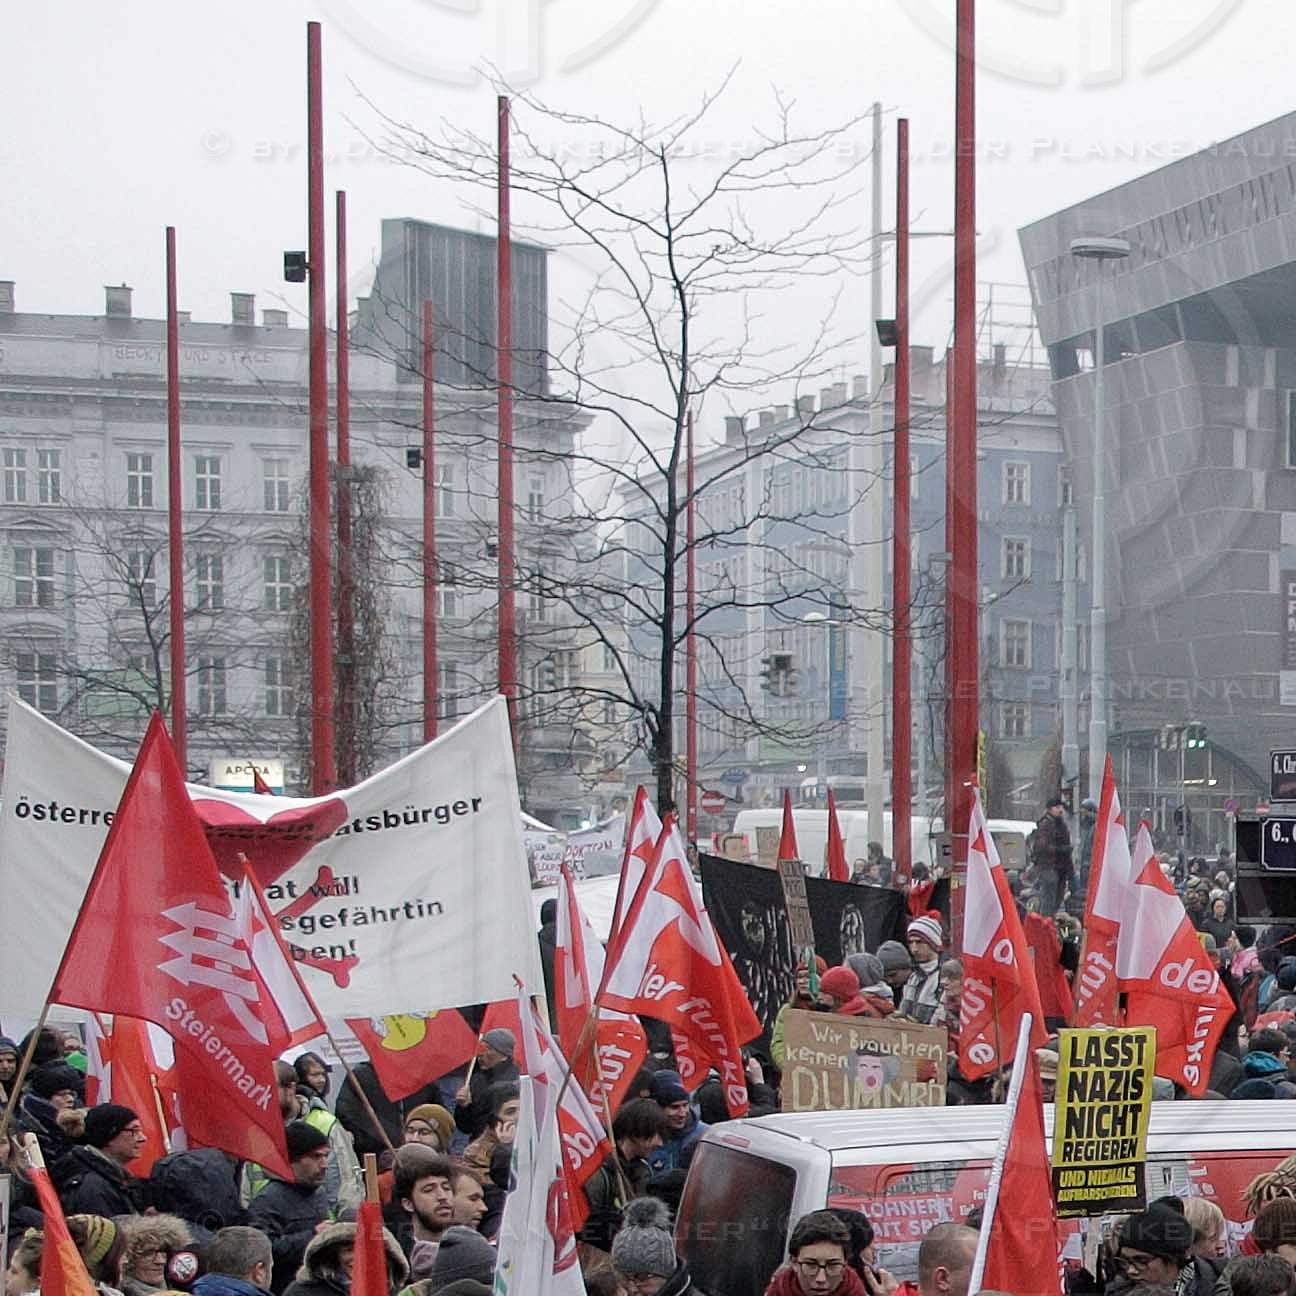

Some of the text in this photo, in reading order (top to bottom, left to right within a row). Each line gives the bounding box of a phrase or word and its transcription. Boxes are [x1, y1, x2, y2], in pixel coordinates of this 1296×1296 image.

[310, 874, 361, 898] will
[279, 897, 445, 936] sgefährtin
[810, 1021, 843, 1046] Wir
[165, 996, 273, 1110] Steiermark
[786, 1045, 849, 1069] keinen
[1070, 1033, 1148, 1069] LASST
[1066, 1068, 1145, 1103] NAZIS
[1064, 1103, 1143, 1139] NICHT
[1062, 1136, 1139, 1163] REGIEREN
[1059, 1165, 1137, 1187] UND NIEMALS
